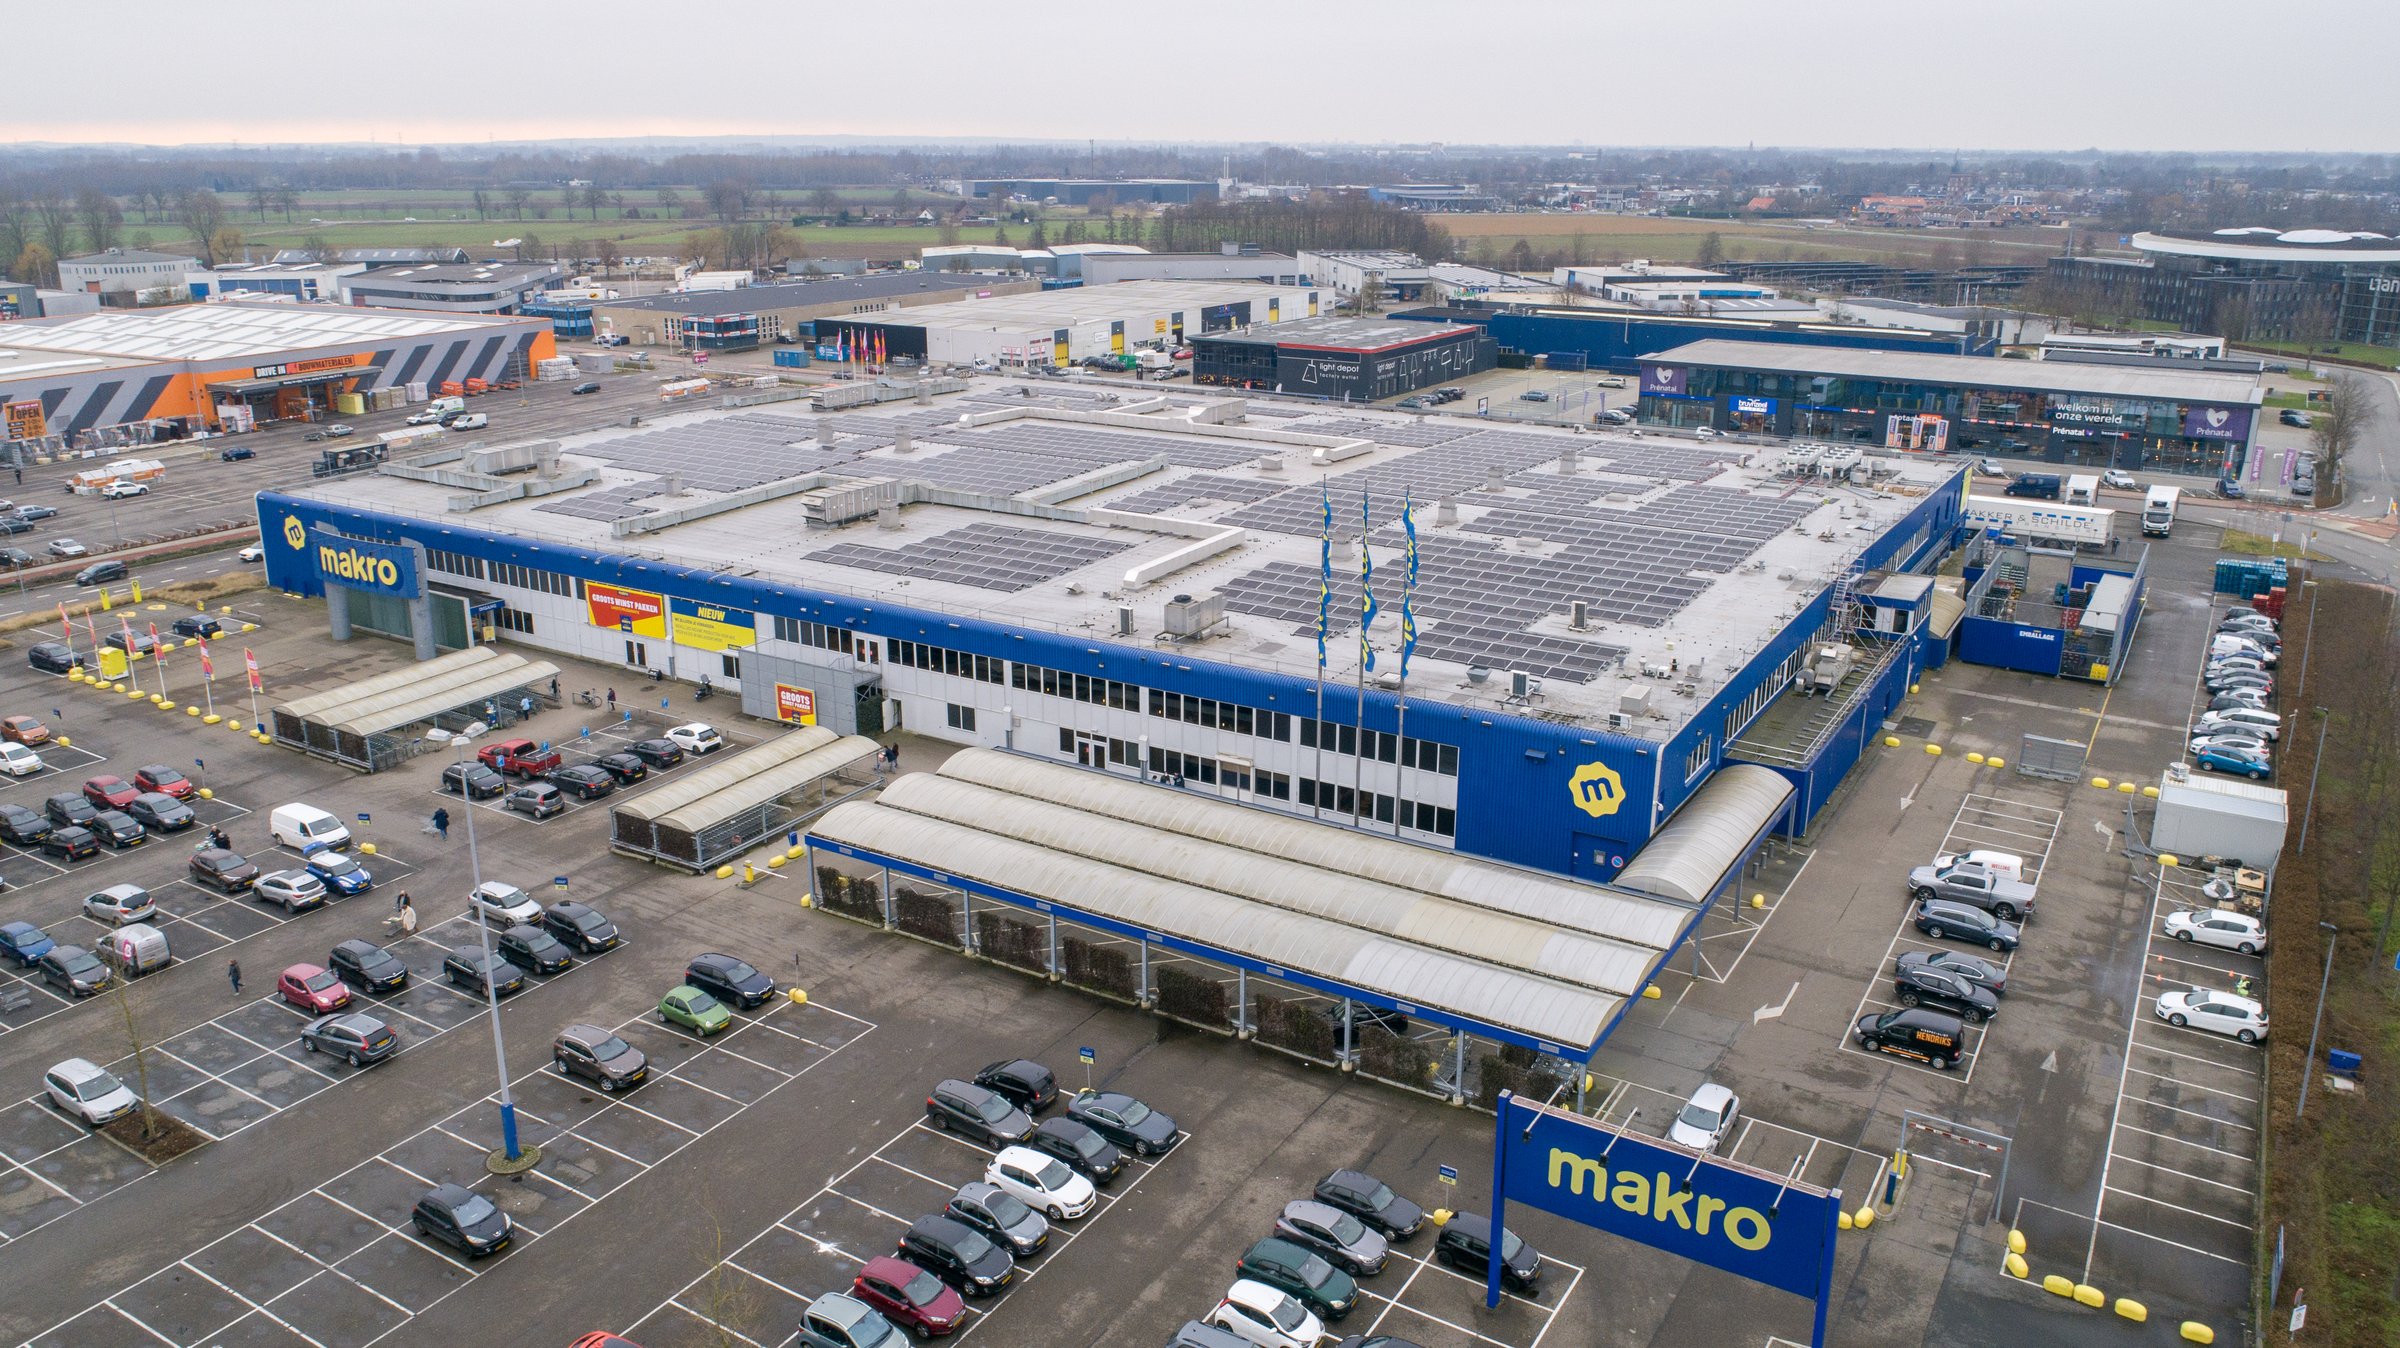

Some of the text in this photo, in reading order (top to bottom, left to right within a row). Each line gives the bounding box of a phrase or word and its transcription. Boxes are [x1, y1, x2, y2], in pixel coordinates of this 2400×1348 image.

[298, 357, 353, 371] BOUWMATERIALEN
[1320, 363, 1359, 373] light depot
[1377, 361, 1396, 373] light depot
[256, 365, 286, 377] DRIVE IN
[1650, 383, 1677, 392] Prénatal
[16, 407, 40, 420] OPEN
[2056, 403, 2113, 414] welkom in
[2055, 411, 2123, 425] onze wereld
[2052, 426, 2086, 437] Prénatal
[2196, 427, 2233, 437] Prénatal
[2018, 514, 2026, 522] &
[319, 545, 398, 586] makro
[592, 593, 615, 605] GROOTS
[615, 597, 634, 609] WINST
[634, 602, 658, 614] PAKKEN
[697, 606, 726, 622] NIEUW
[2019, 630, 2055, 641] EMBALLAGE
[781, 690, 810, 705] GROOTS
[1580, 777, 1614, 803] m
[1916, 1030, 1952, 1047] HENDRIKS
[1548, 1147, 1772, 1252] makro
